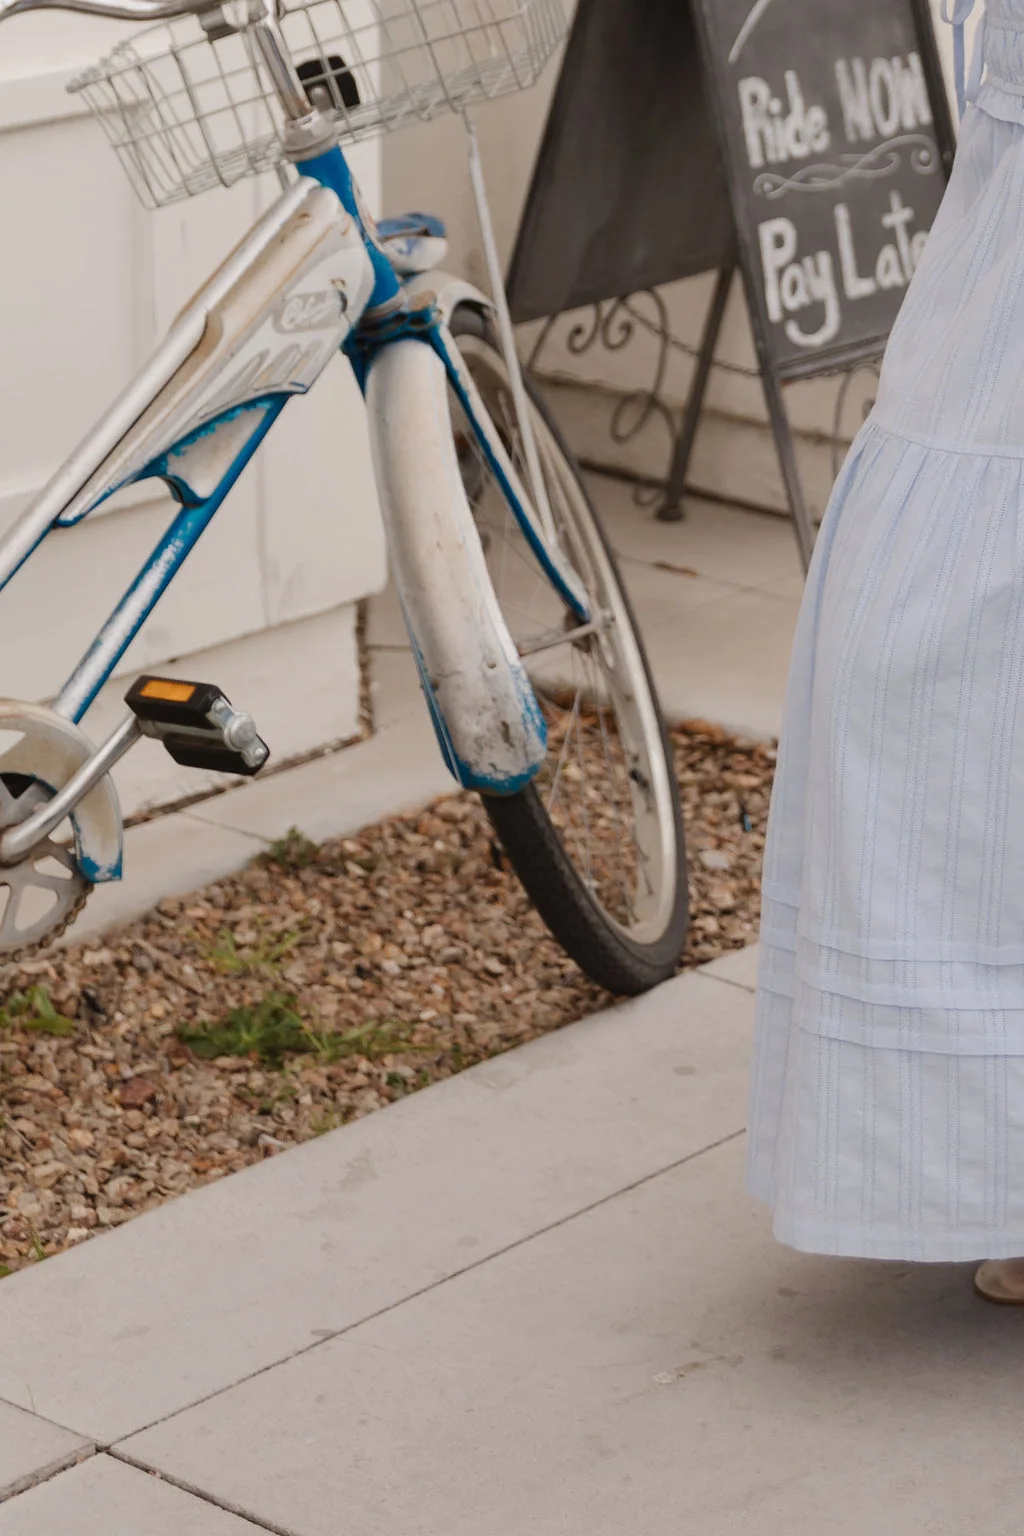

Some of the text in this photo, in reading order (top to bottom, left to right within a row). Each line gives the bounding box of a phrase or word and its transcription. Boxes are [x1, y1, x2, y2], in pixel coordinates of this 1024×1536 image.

[737, 51, 932, 168] Ride NOW
[757, 189, 931, 347] Pay Late
